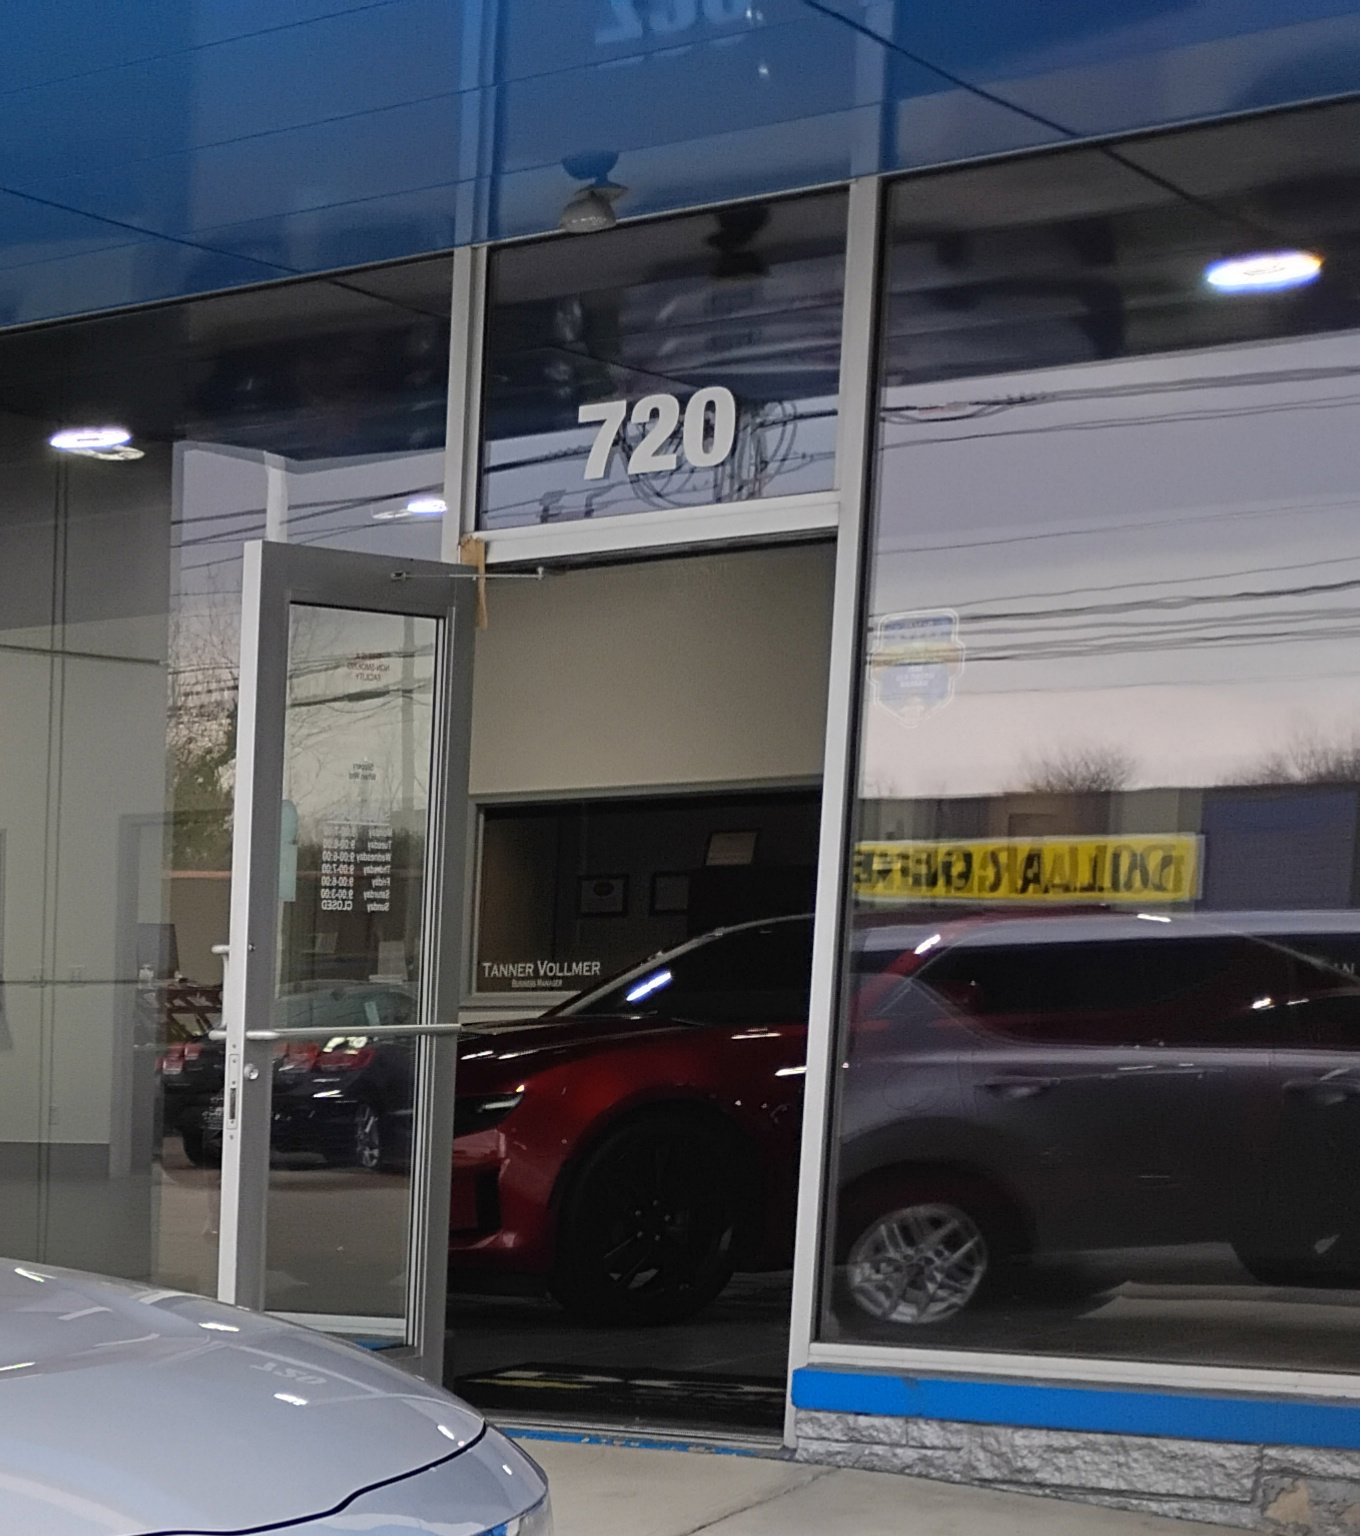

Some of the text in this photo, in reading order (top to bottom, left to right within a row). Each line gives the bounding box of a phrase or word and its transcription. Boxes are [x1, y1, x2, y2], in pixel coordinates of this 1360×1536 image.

[577, 385, 737, 482] 720
[481, 959, 601, 978] TANNER VOLLMER
